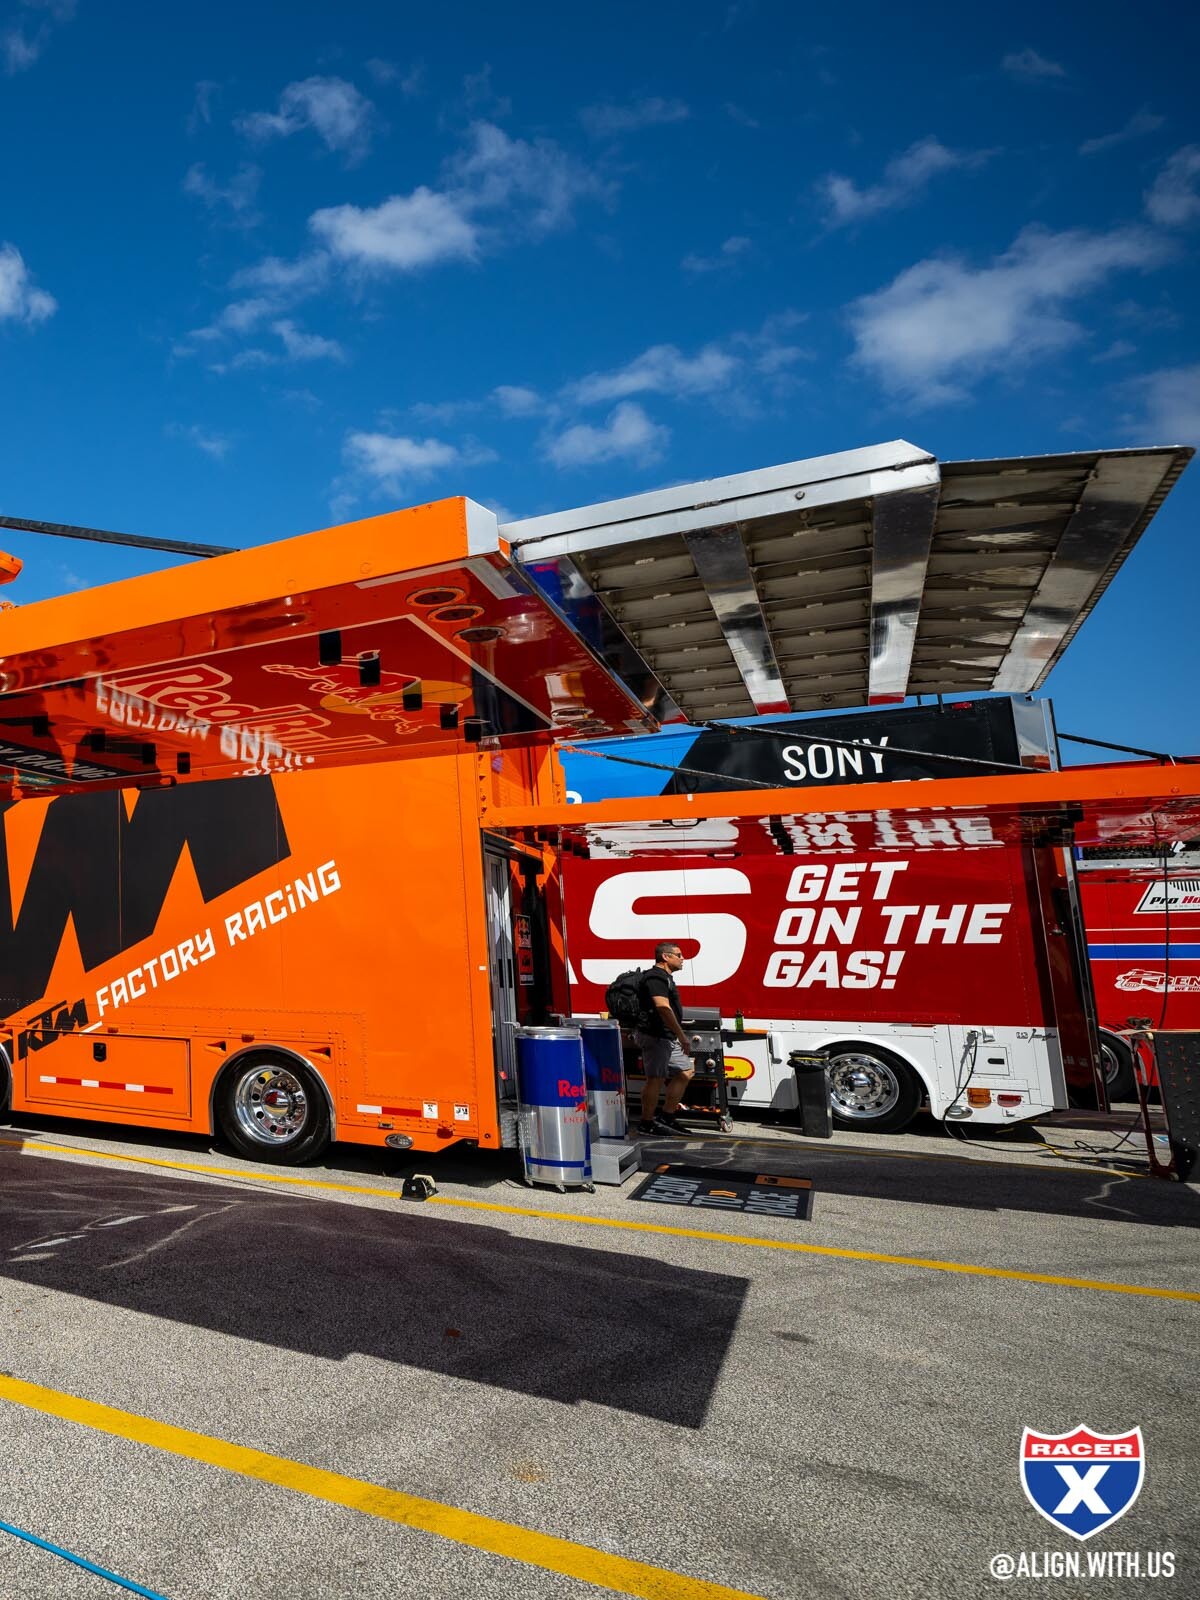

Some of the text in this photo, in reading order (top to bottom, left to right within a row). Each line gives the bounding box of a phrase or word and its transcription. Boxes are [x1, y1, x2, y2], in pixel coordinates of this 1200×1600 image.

[101, 663, 311, 726] Red
[6, 753, 118, 780] RACING
[781, 735, 889, 782] SONY
[785, 860, 909, 902] GET
[773, 903, 1012, 945] ON THE
[96, 928, 216, 1017] FACTORY
[762, 950, 906, 989] GAS!
[18, 998, 89, 1062] KTM
